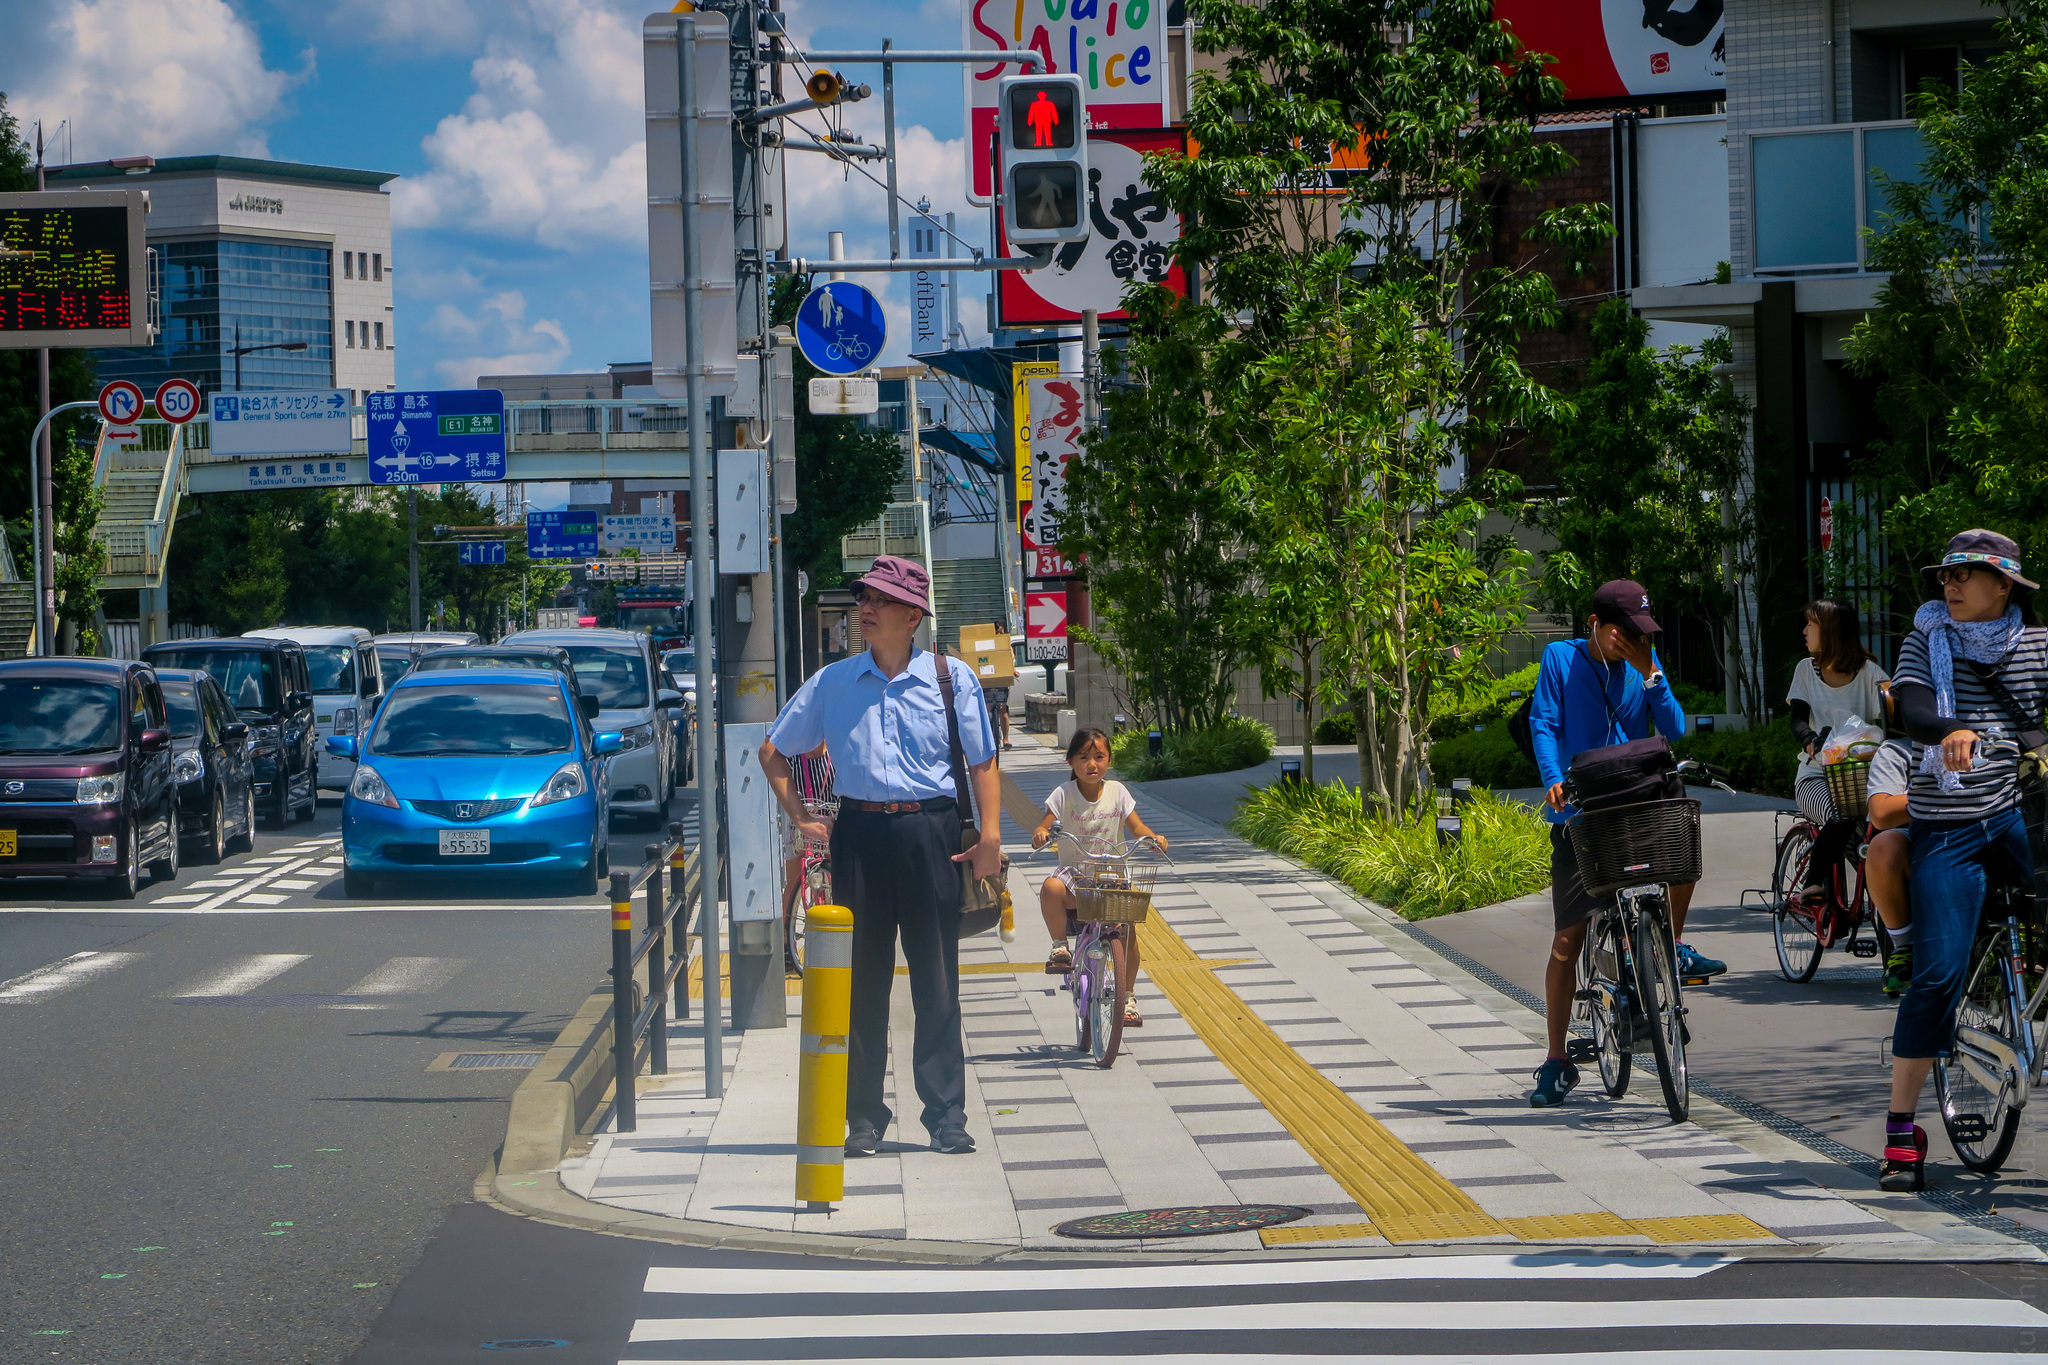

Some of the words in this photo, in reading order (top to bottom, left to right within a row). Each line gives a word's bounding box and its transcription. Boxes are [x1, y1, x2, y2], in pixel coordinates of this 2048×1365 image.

[1018, 25, 1151, 90] Alice
[1105, 239, 1169, 283] 食堂
[916, 270, 935, 343] oftBank
[165, 392, 190, 411] 50
[240, 395, 324, 411] 総合スポーツセンター
[370, 395, 396, 411] 京都
[403, 394, 429, 410] 島本
[243, 411, 271, 421] General
[274, 411, 298, 421] Sports
[300, 410, 323, 420] Center
[371, 412, 395, 422] Kyoto
[401, 410, 432, 420] Shimamoto
[471, 415, 493, 427] 名神
[394, 437, 407, 447] 171
[420, 455, 433, 466] 16
[465, 452, 501, 468] 摂津
[249, 465, 292, 478] 高槻市
[303, 462, 346, 475] 桃園町
[471, 469, 496, 478] Settsu
[249, 477, 286, 486] Takatsuki
[291, 476, 307, 485] City
[312, 474, 346, 483] Toencho
[386, 471, 419, 483] 250m
[450, 840, 487, 853] 55-35
